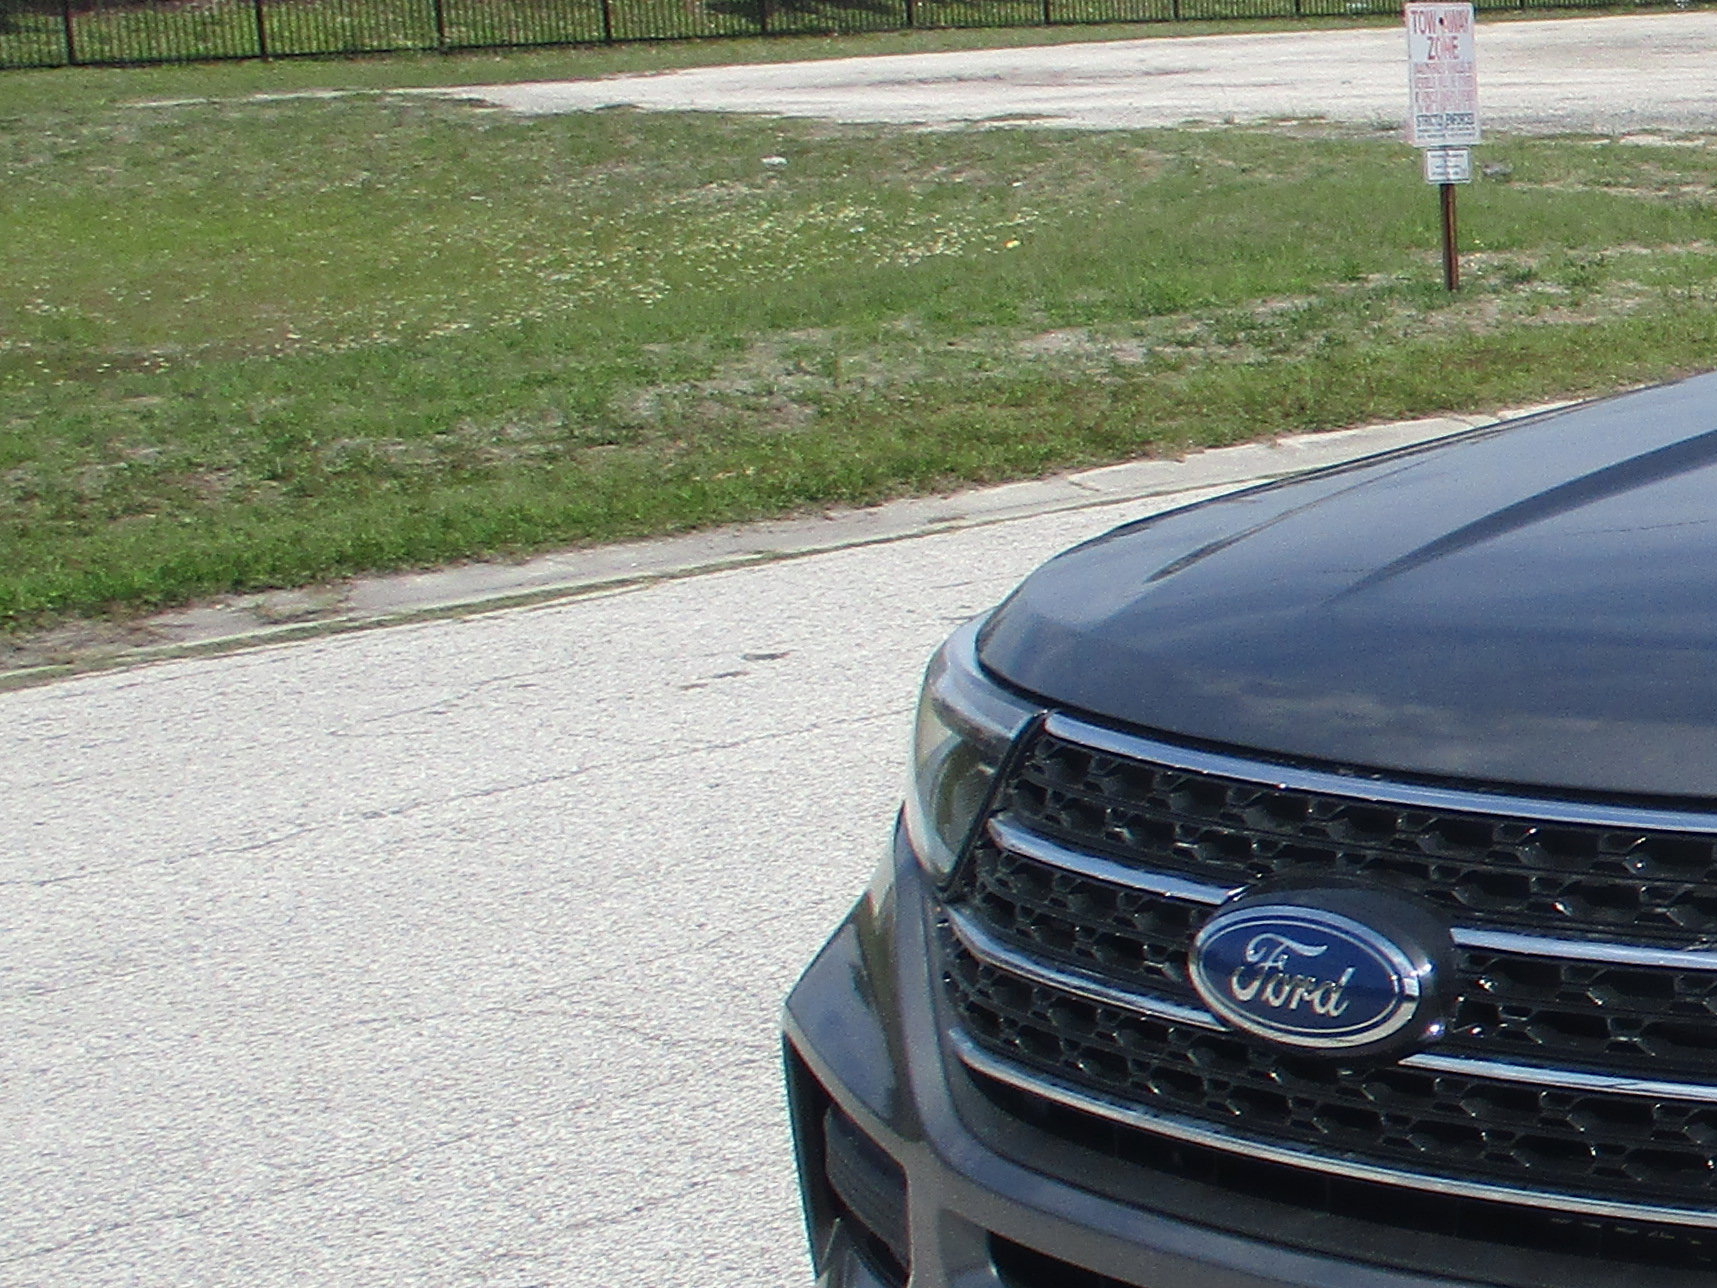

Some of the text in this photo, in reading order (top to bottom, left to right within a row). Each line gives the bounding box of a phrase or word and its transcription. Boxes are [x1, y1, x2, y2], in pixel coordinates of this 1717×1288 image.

[1410, 9, 1437, 34] TOW
[1427, 36, 1460, 61] ZONE
[1231, 932, 1356, 1018] Ford
